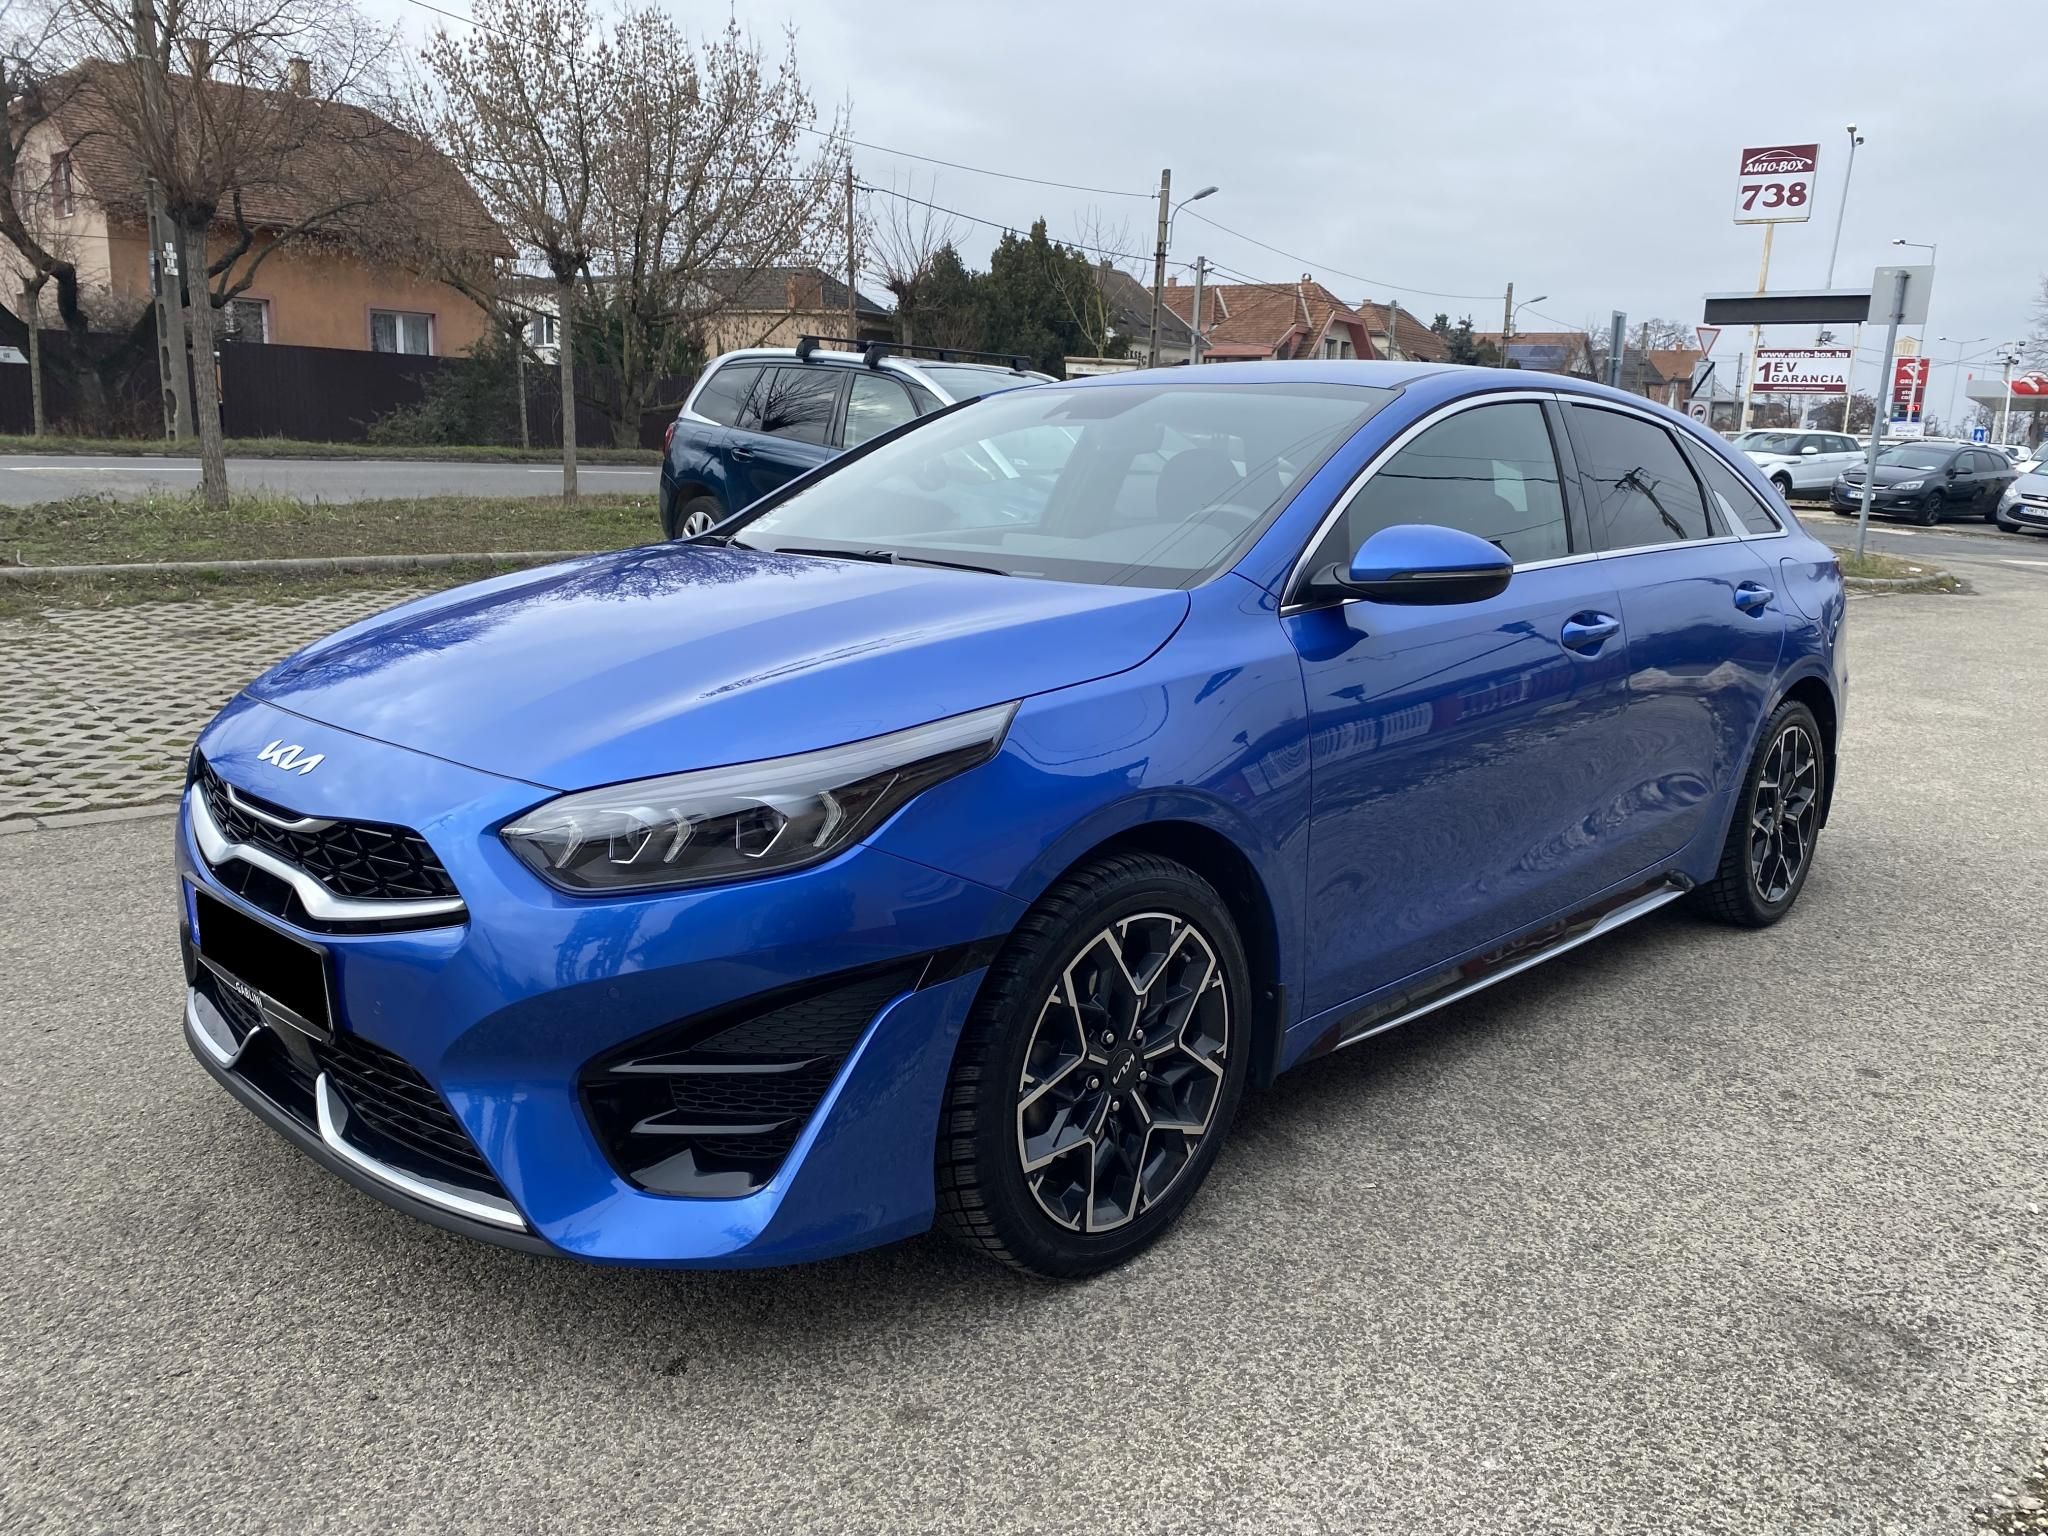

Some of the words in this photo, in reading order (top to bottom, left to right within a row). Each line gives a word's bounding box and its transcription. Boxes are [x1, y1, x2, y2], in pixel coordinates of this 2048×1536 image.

[1743, 160, 1805, 172] AUTO-BOX
[1741, 182, 1807, 211] 738
[1760, 350, 1848, 359] www.auto-box.hu
[1758, 361, 1772, 383] 1
[1773, 359, 1797, 373] ÉV
[1771, 374, 1844, 383] GARANCIA
[256, 739, 326, 777] KIA
[235, 981, 263, 1009] GABLINI
